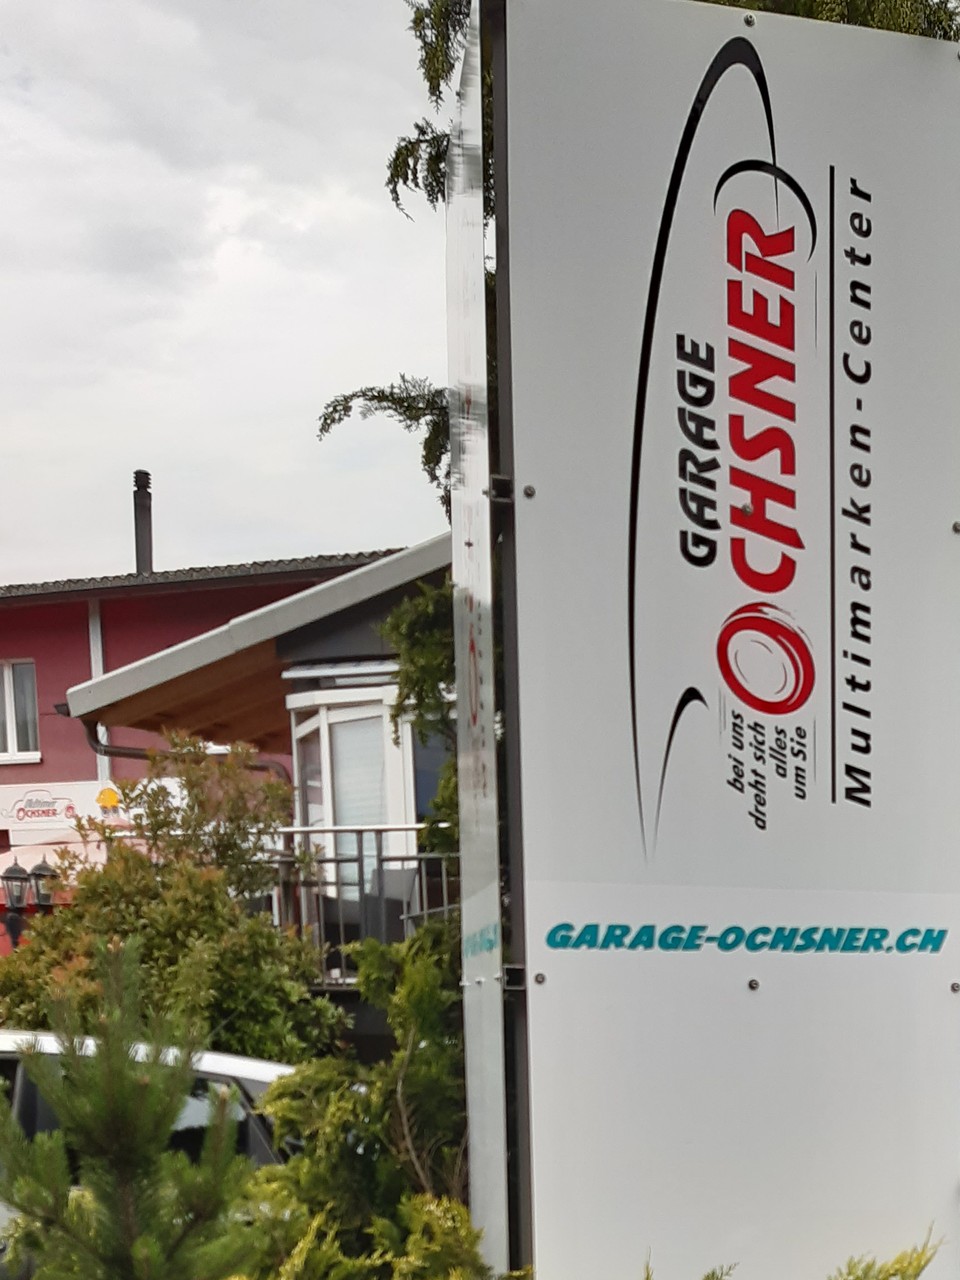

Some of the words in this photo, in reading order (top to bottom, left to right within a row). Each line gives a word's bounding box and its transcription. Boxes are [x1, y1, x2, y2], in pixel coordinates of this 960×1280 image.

[676, 334, 721, 567] GARAGE
[716, 207, 816, 716] OCHSNER
[842, 177, 873, 808] Multimarken-Center
[731, 709, 745, 752] uns
[746, 720, 766, 766] sich
[768, 725, 788, 779] alles
[790, 725, 808, 762] Sie
[726, 753, 745, 794] bei
[794, 765, 807, 801] um
[747, 768, 767, 831] dreht
[546, 923, 950, 954] GARAGE-OCHSNER.CH
